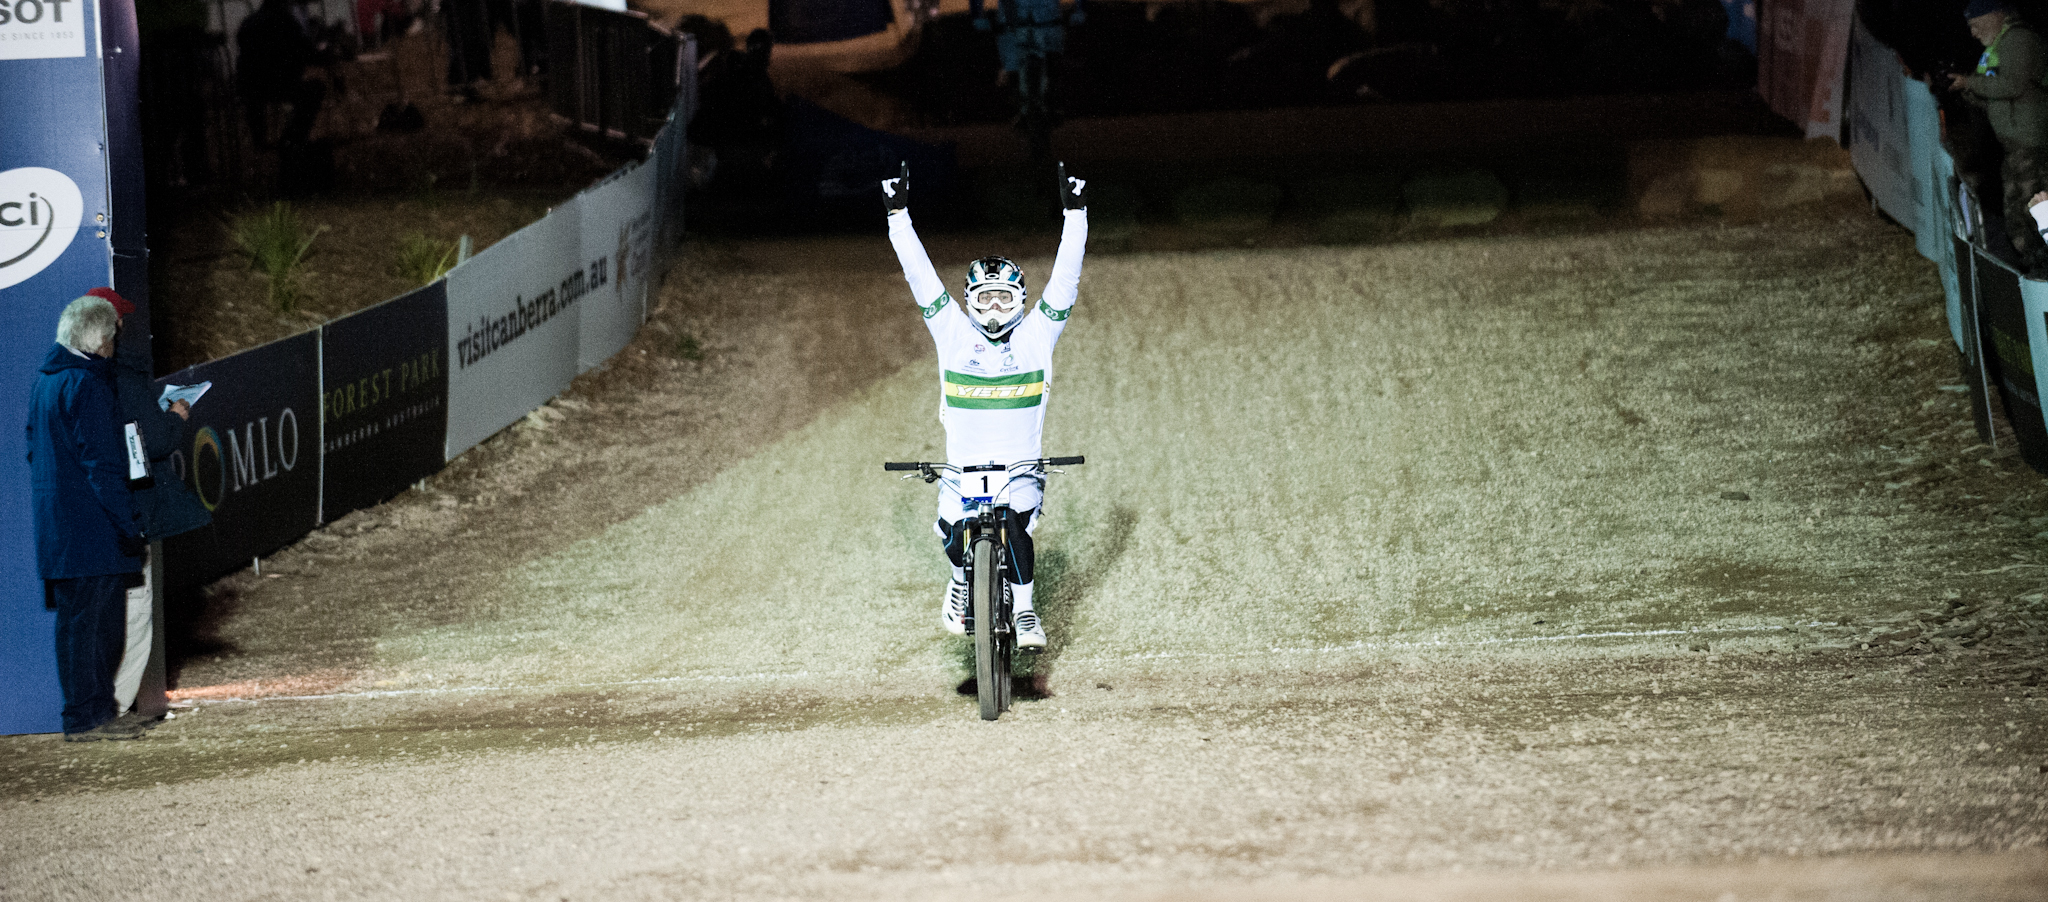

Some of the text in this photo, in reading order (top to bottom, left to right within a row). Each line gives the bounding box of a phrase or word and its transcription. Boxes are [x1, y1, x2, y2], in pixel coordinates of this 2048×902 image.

[12, 32, 45, 41] SINCE
[51, 31, 74, 39] 1853
[457, 255, 607, 369] visitcanberra.com.au
[324, 348, 439, 423] FOREST PARK
[956, 384, 1028, 397] YETI
[981, 475, 989, 494] 1
